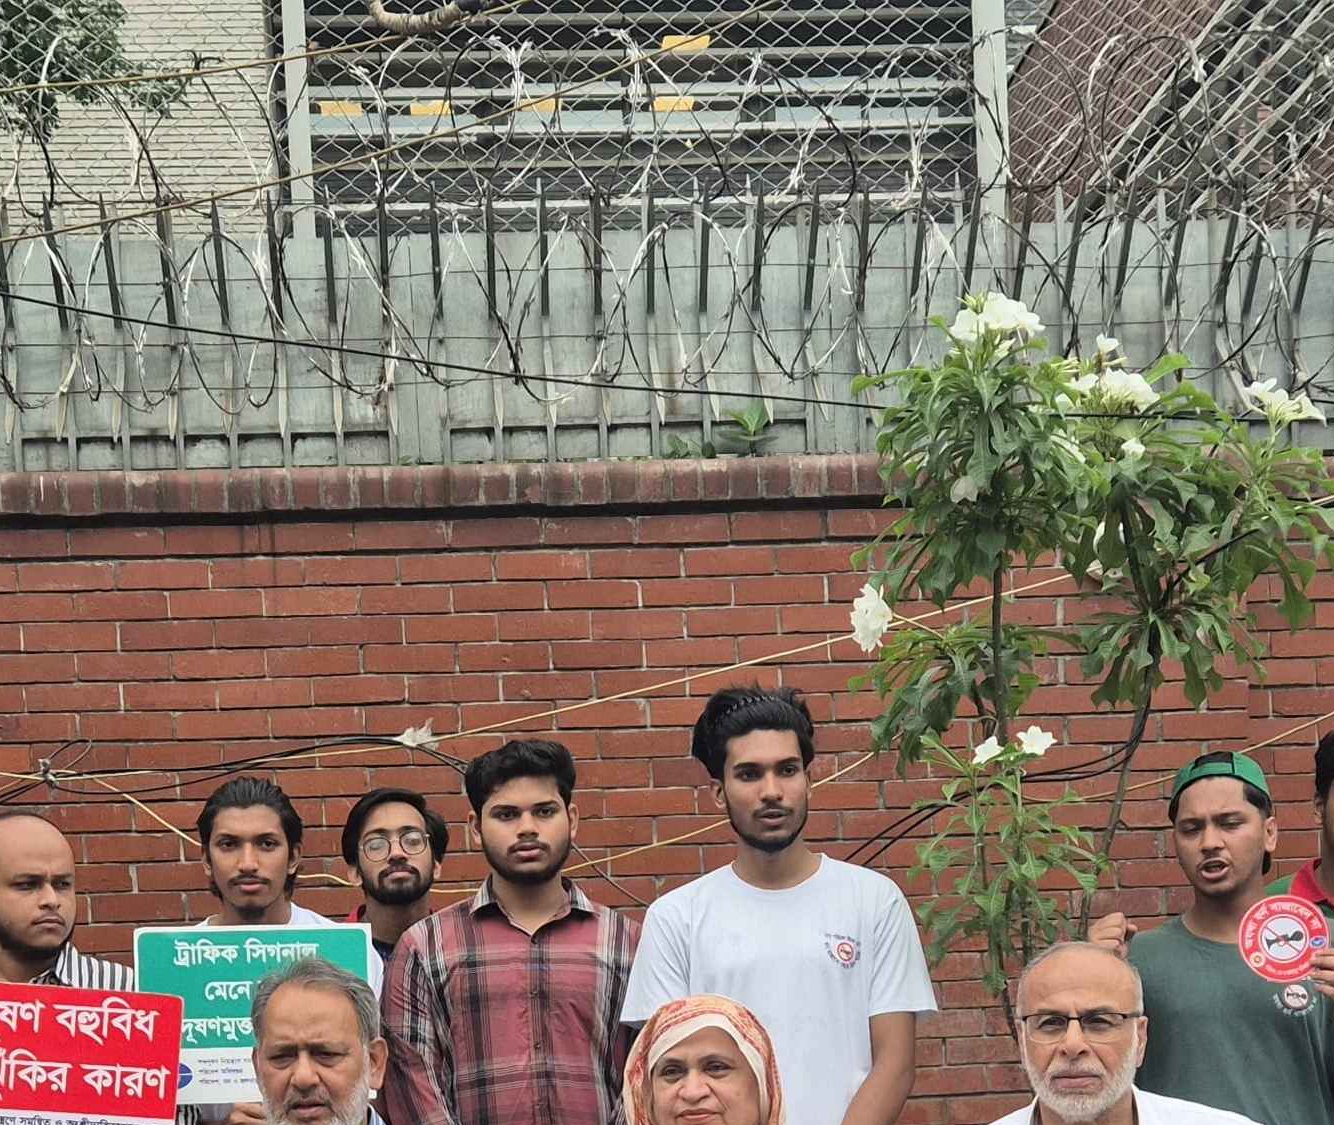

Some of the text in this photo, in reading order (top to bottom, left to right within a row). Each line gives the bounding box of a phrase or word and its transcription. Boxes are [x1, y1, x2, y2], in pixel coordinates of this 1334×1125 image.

[174, 937, 319, 967] ট্রাফিক সিগনাল
[205, 980, 254, 1000] মেনে
[55, 997, 160, 1044] বহুবিধ
[181, 1017, 253, 1044] দূষণমুক্ত
[81, 1063, 171, 1099] কারণ
